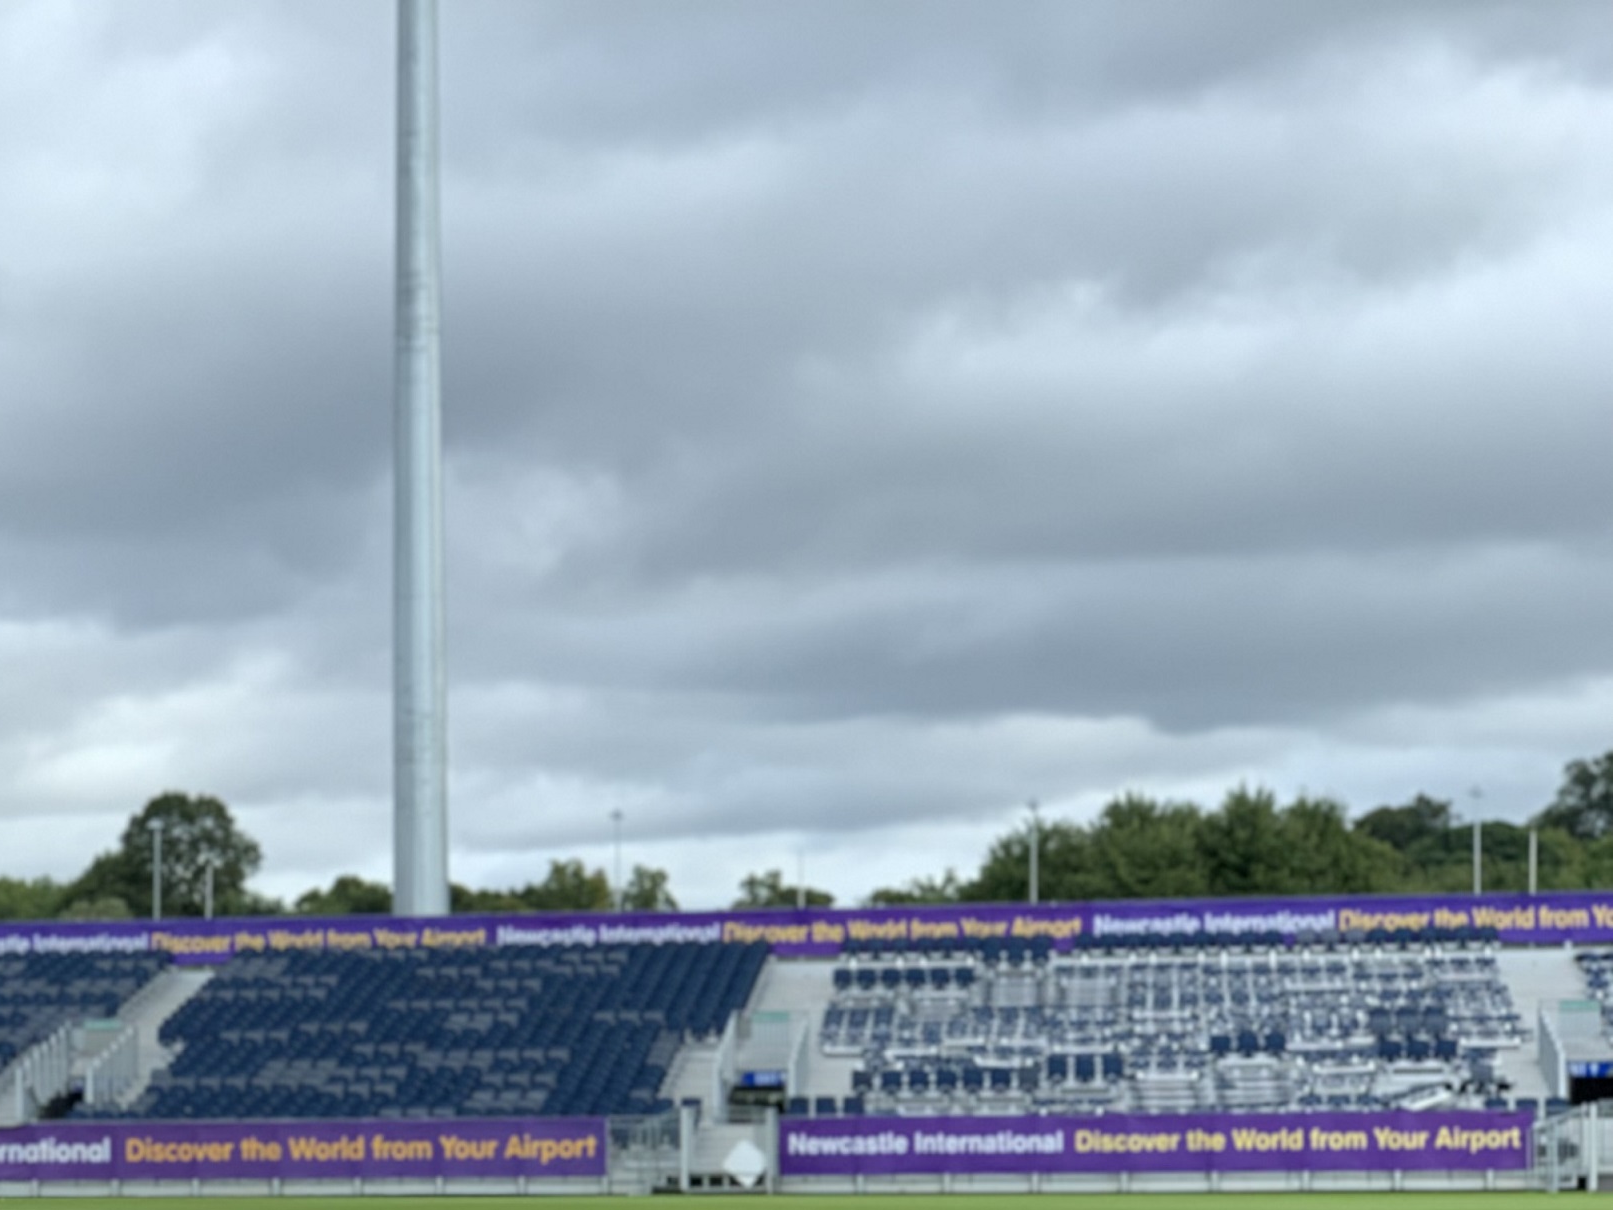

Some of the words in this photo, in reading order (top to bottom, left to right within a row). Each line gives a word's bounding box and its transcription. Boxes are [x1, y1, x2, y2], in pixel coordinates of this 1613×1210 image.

[723, 920, 808, 943] Discover
[812, 918, 844, 942] the
[847, 917, 907, 938] World
[911, 917, 958, 938] from
[960, 916, 1008, 937] Your
[1011, 914, 1082, 939] Airport
[1094, 913, 1201, 936] Newcastle
[1204, 909, 1335, 934] International
[1339, 909, 1429, 932] Discover
[1434, 906, 1468, 928] the
[1472, 904, 1534, 929] World
[1539, 904, 1588, 929] from
[33, 932, 149, 954] International
[151, 931, 230, 954] Discover
[235, 931, 265, 949] the
[268, 929, 324, 949] World
[327, 928, 372, 949] from
[374, 928, 418, 948] Your
[421, 928, 485, 947] Airport
[497, 924, 596, 947] Newcastle
[599, 922, 720, 945] International
[125, 1137, 234, 1162] Discover
[240, 1135, 282, 1161] the
[288, 1134, 365, 1161] World
[371, 1133, 433, 1161] from
[439, 1135, 499, 1160] Your
[503, 1133, 597, 1166] Airport
[788, 1132, 909, 1155] Newcastle
[914, 1130, 1065, 1153] International
[1074, 1129, 1181, 1152] Discover
[1186, 1128, 1227, 1151] the
[1232, 1127, 1304, 1151] World
[1309, 1127, 1368, 1151] from
[1374, 1127, 1429, 1149] Your
[1434, 1126, 1521, 1154] Airport
